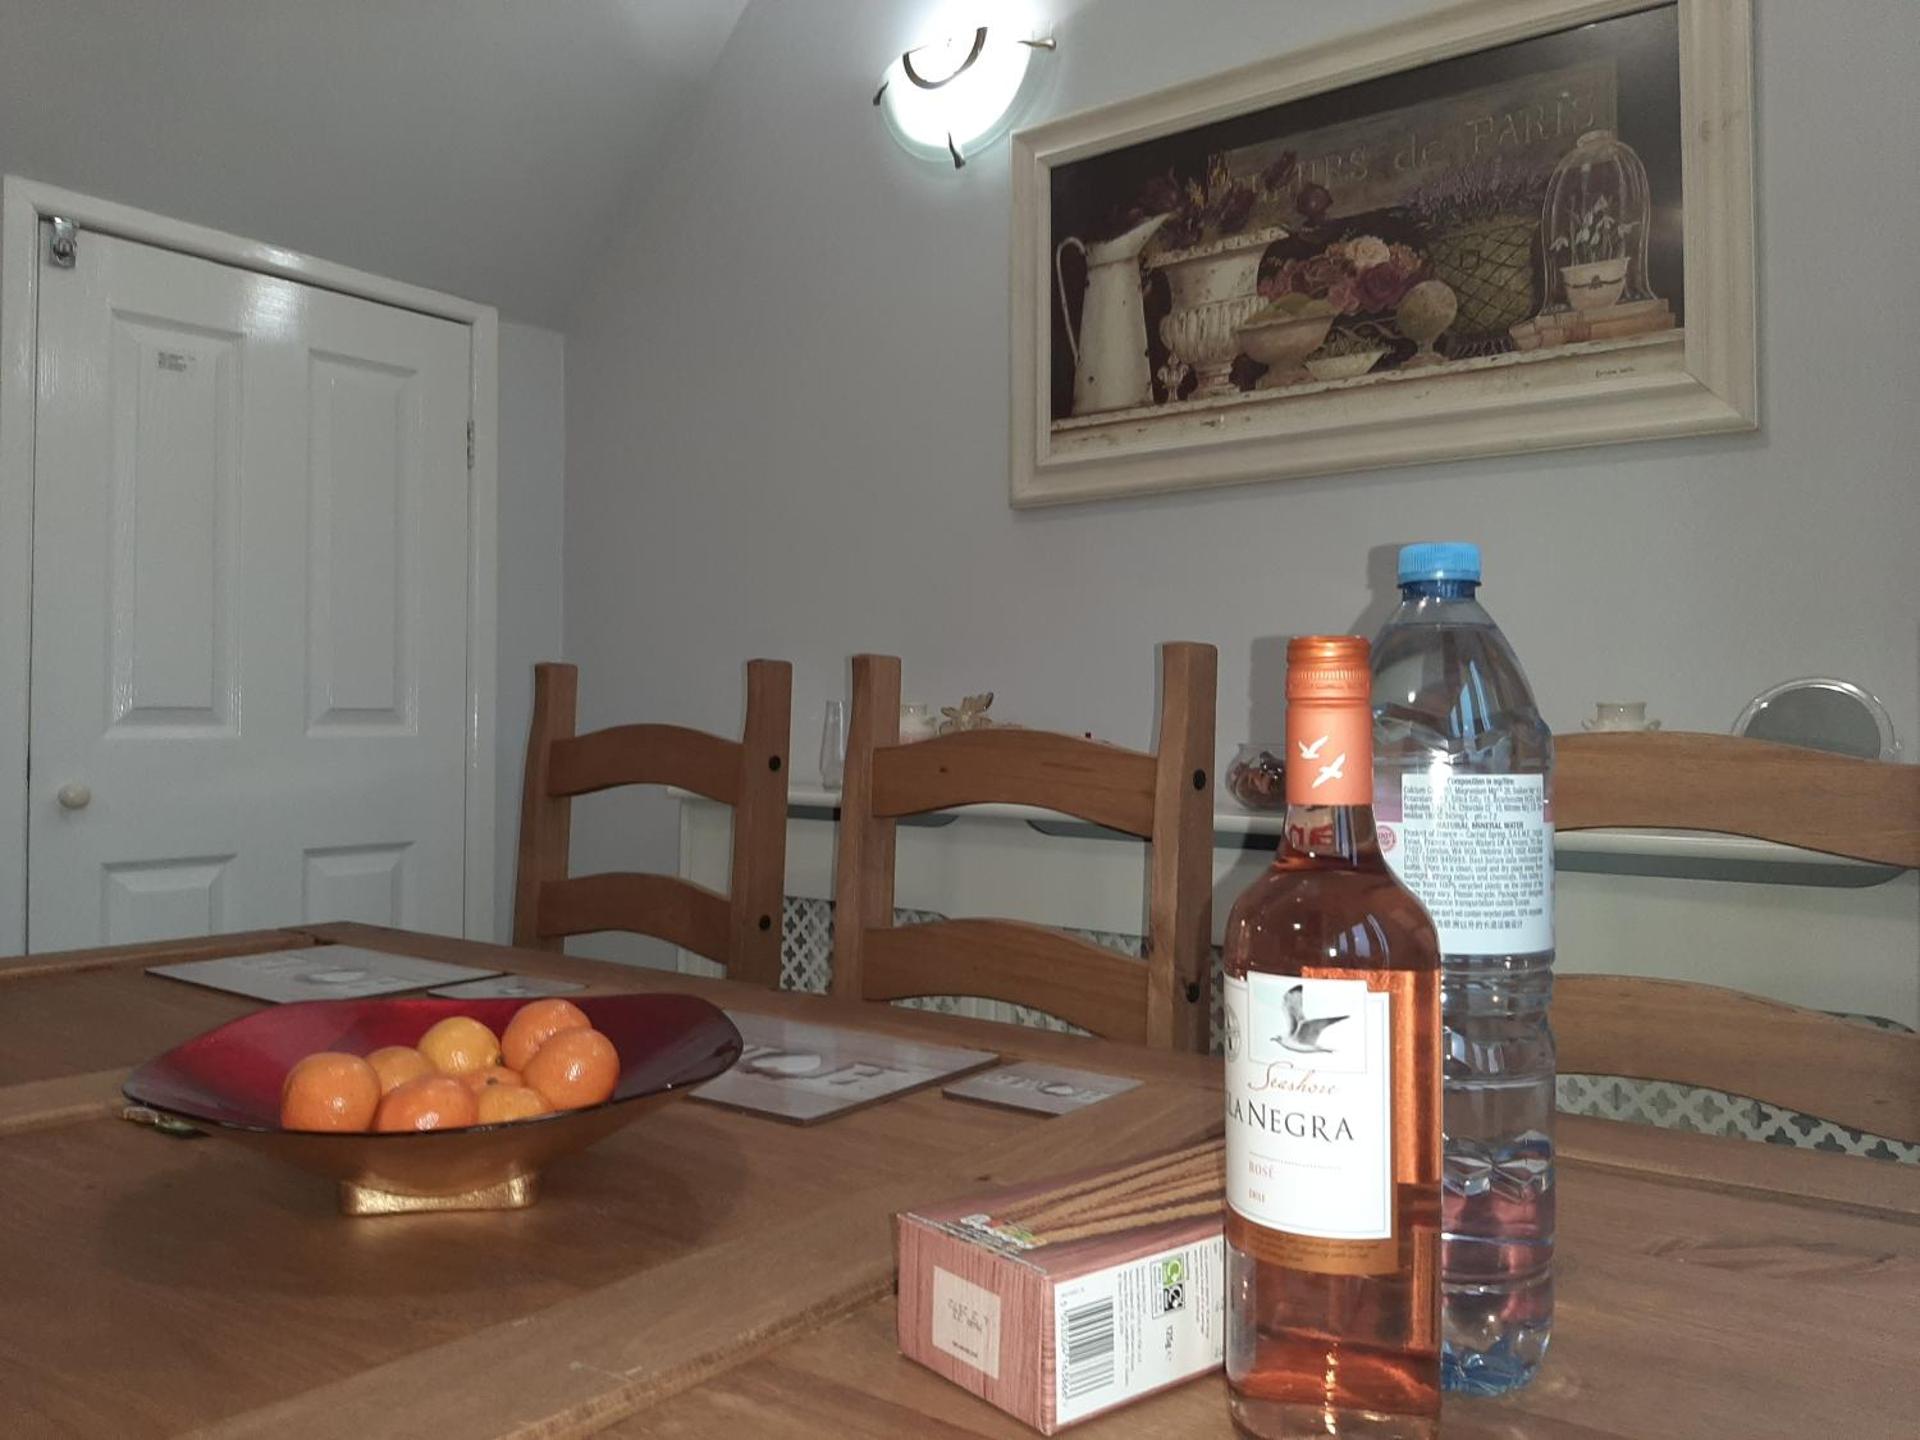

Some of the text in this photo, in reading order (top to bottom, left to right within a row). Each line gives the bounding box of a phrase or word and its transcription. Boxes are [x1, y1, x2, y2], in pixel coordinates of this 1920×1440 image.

[1437, 821, 1524, 830] NATURAL MINERAL WATER
[1247, 1060, 1340, 1096] Seashore
[1247, 1097, 1355, 1144] NEGRA
